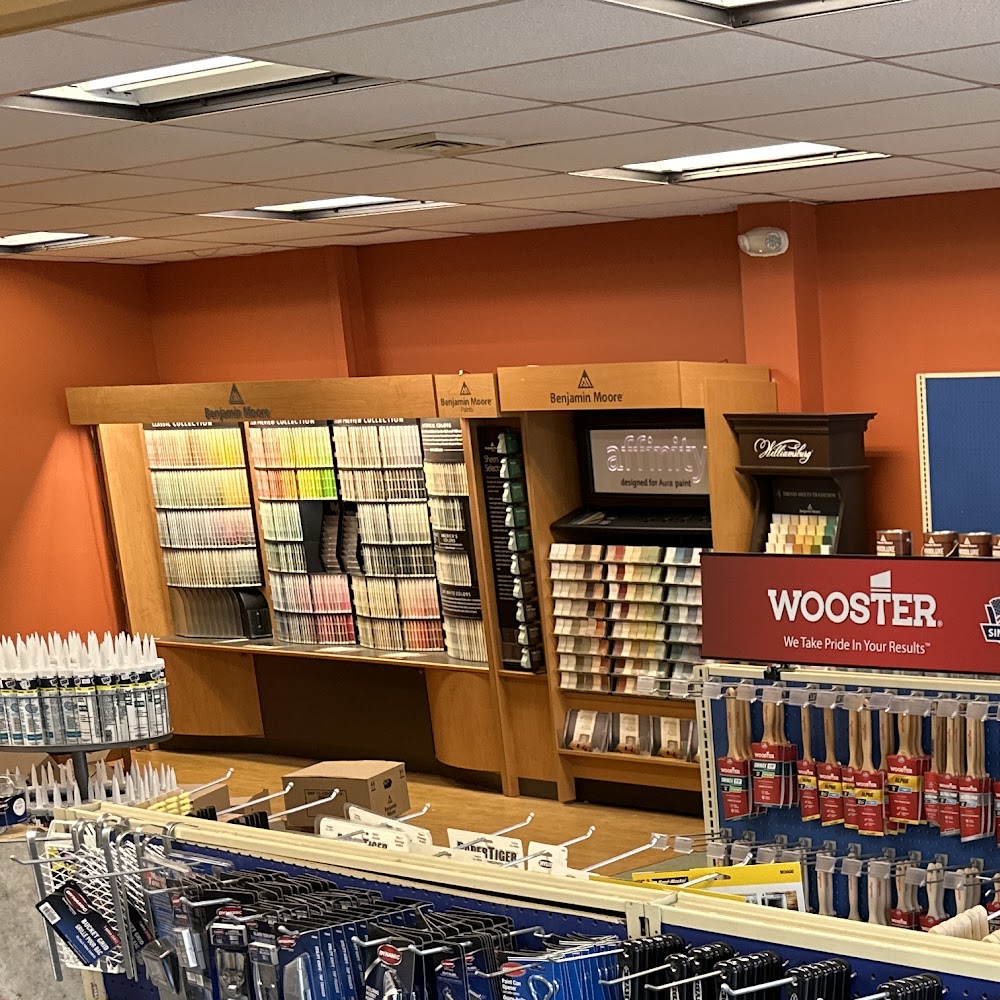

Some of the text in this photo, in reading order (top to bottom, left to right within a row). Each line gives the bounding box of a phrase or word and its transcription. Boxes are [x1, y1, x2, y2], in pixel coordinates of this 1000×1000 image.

[440, 397, 492, 407] Benjamin Moore
[550, 392, 622, 406] Benjamin Moore
[621, 479, 648, 487] designed
[675, 479, 692, 488] paint
[768, 578, 939, 628] WOOSTER
[784, 636, 799, 648] We
[800, 637, 822, 649] Take
[825, 639, 850, 650] Pride
[852, 639, 862, 651] In
[864, 640, 887, 652] Your
[379, 951, 401, 960] DYNAMIC
